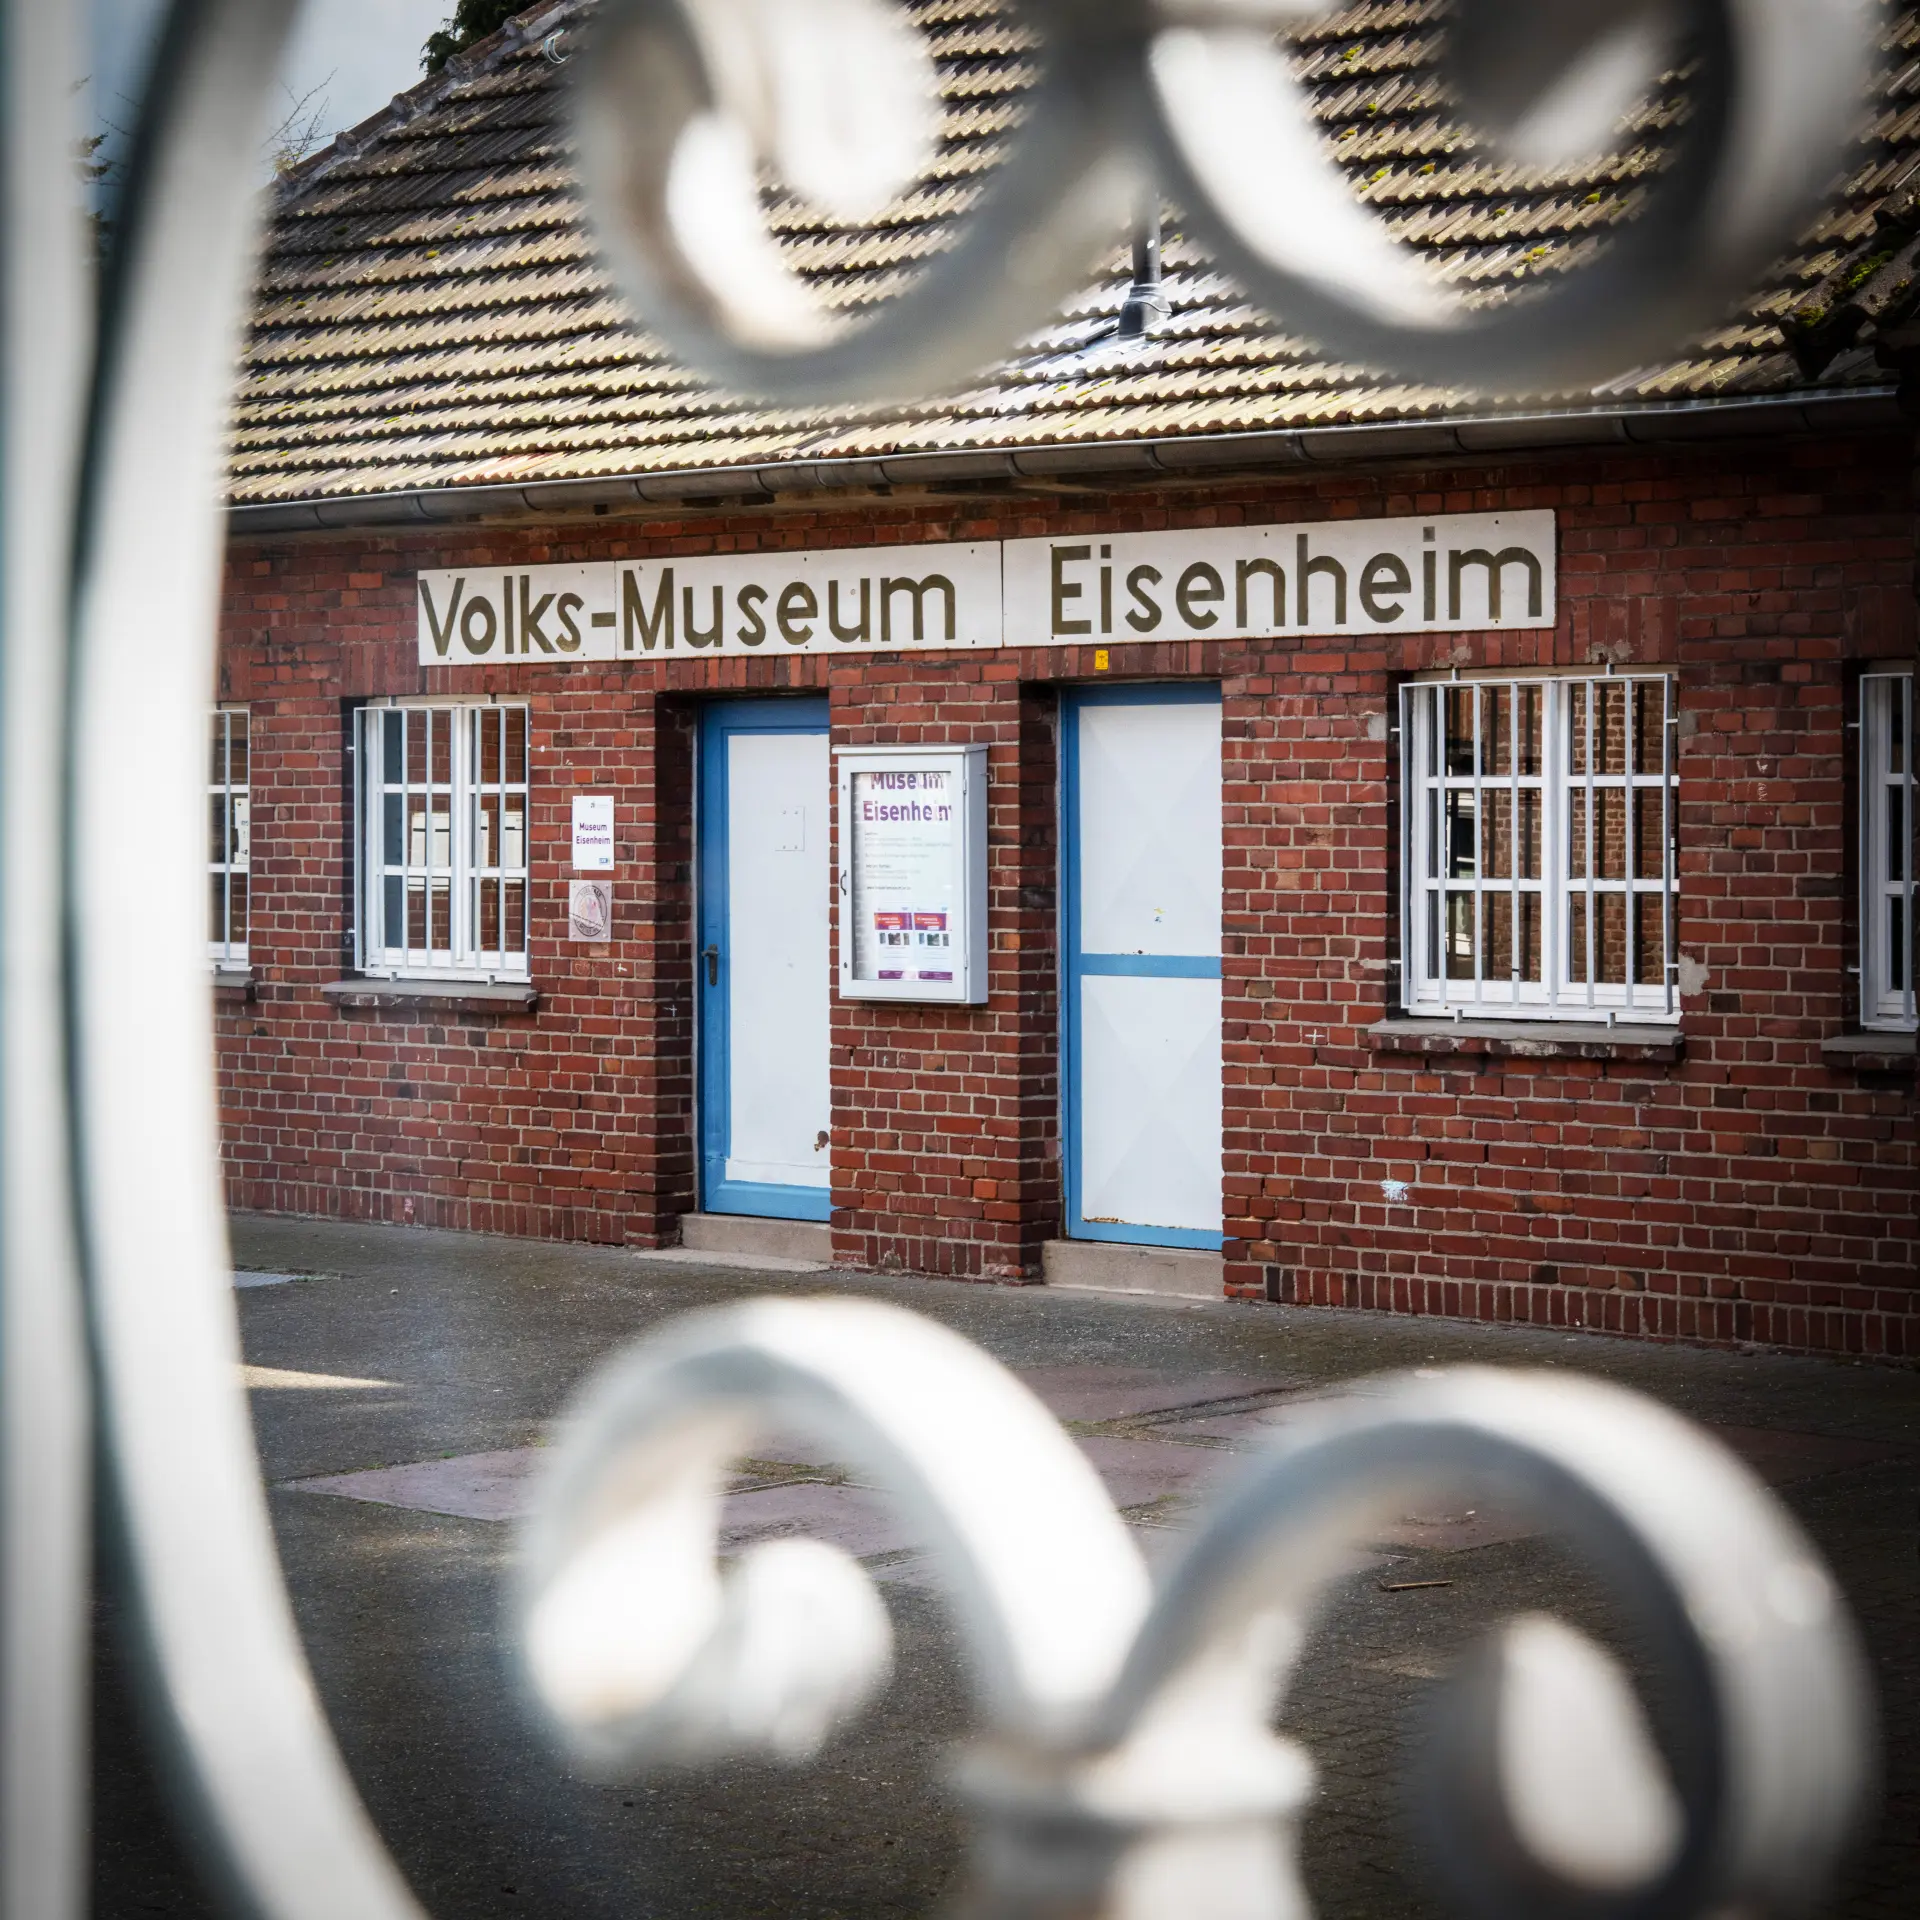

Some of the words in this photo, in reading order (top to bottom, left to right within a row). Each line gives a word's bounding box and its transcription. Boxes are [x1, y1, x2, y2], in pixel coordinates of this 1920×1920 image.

[420, 567, 956, 657] Volks-Museum
[1050, 526, 1543, 635] Eisenheim
[579, 822, 607, 831] Museum
[576, 835, 611, 845] Eisenheim
